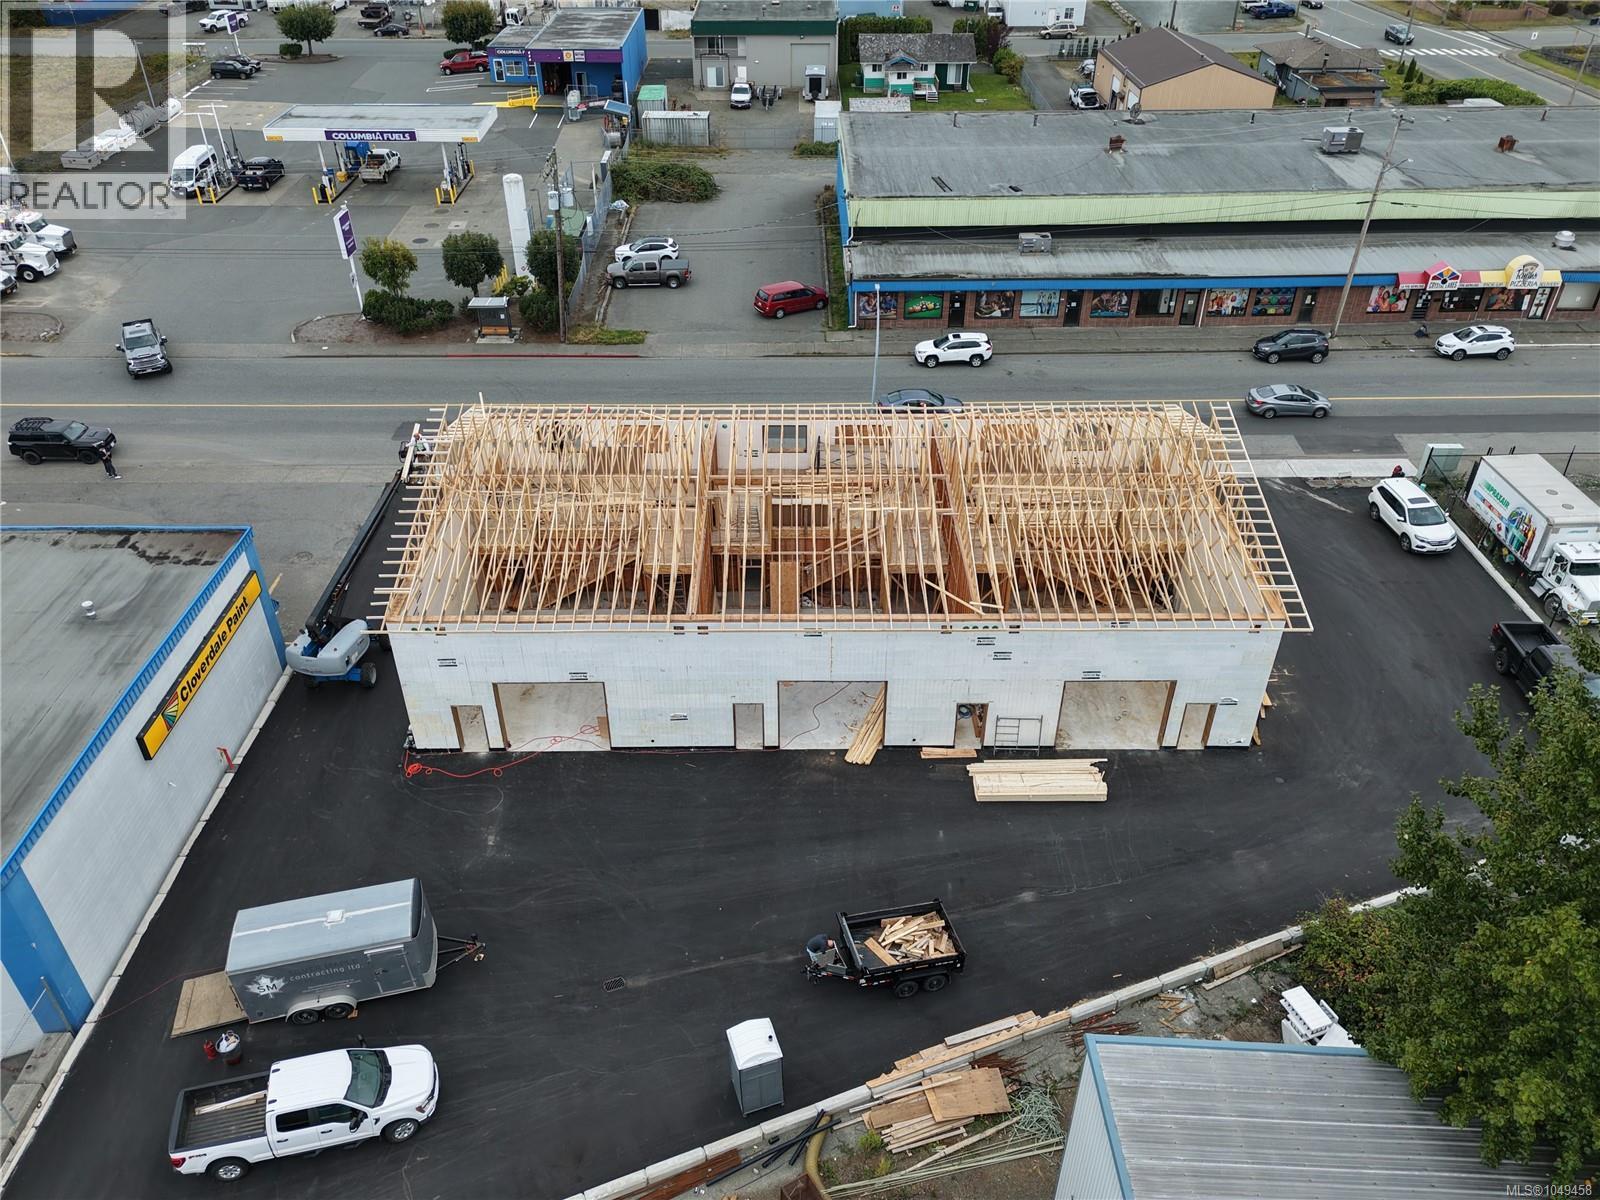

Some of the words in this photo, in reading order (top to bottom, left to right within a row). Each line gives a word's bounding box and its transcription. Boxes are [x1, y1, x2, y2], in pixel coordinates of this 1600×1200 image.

[331, 132, 383, 141] COLUMBIA
[383, 132, 410, 141] FUELS
[1488, 486, 1510, 509] PRAXAIR
[180, 632, 228, 702] Cloverdale
[225, 597, 249, 632] Paint
[257, 983, 278, 993] SM
[289, 966, 345, 982] contracting
